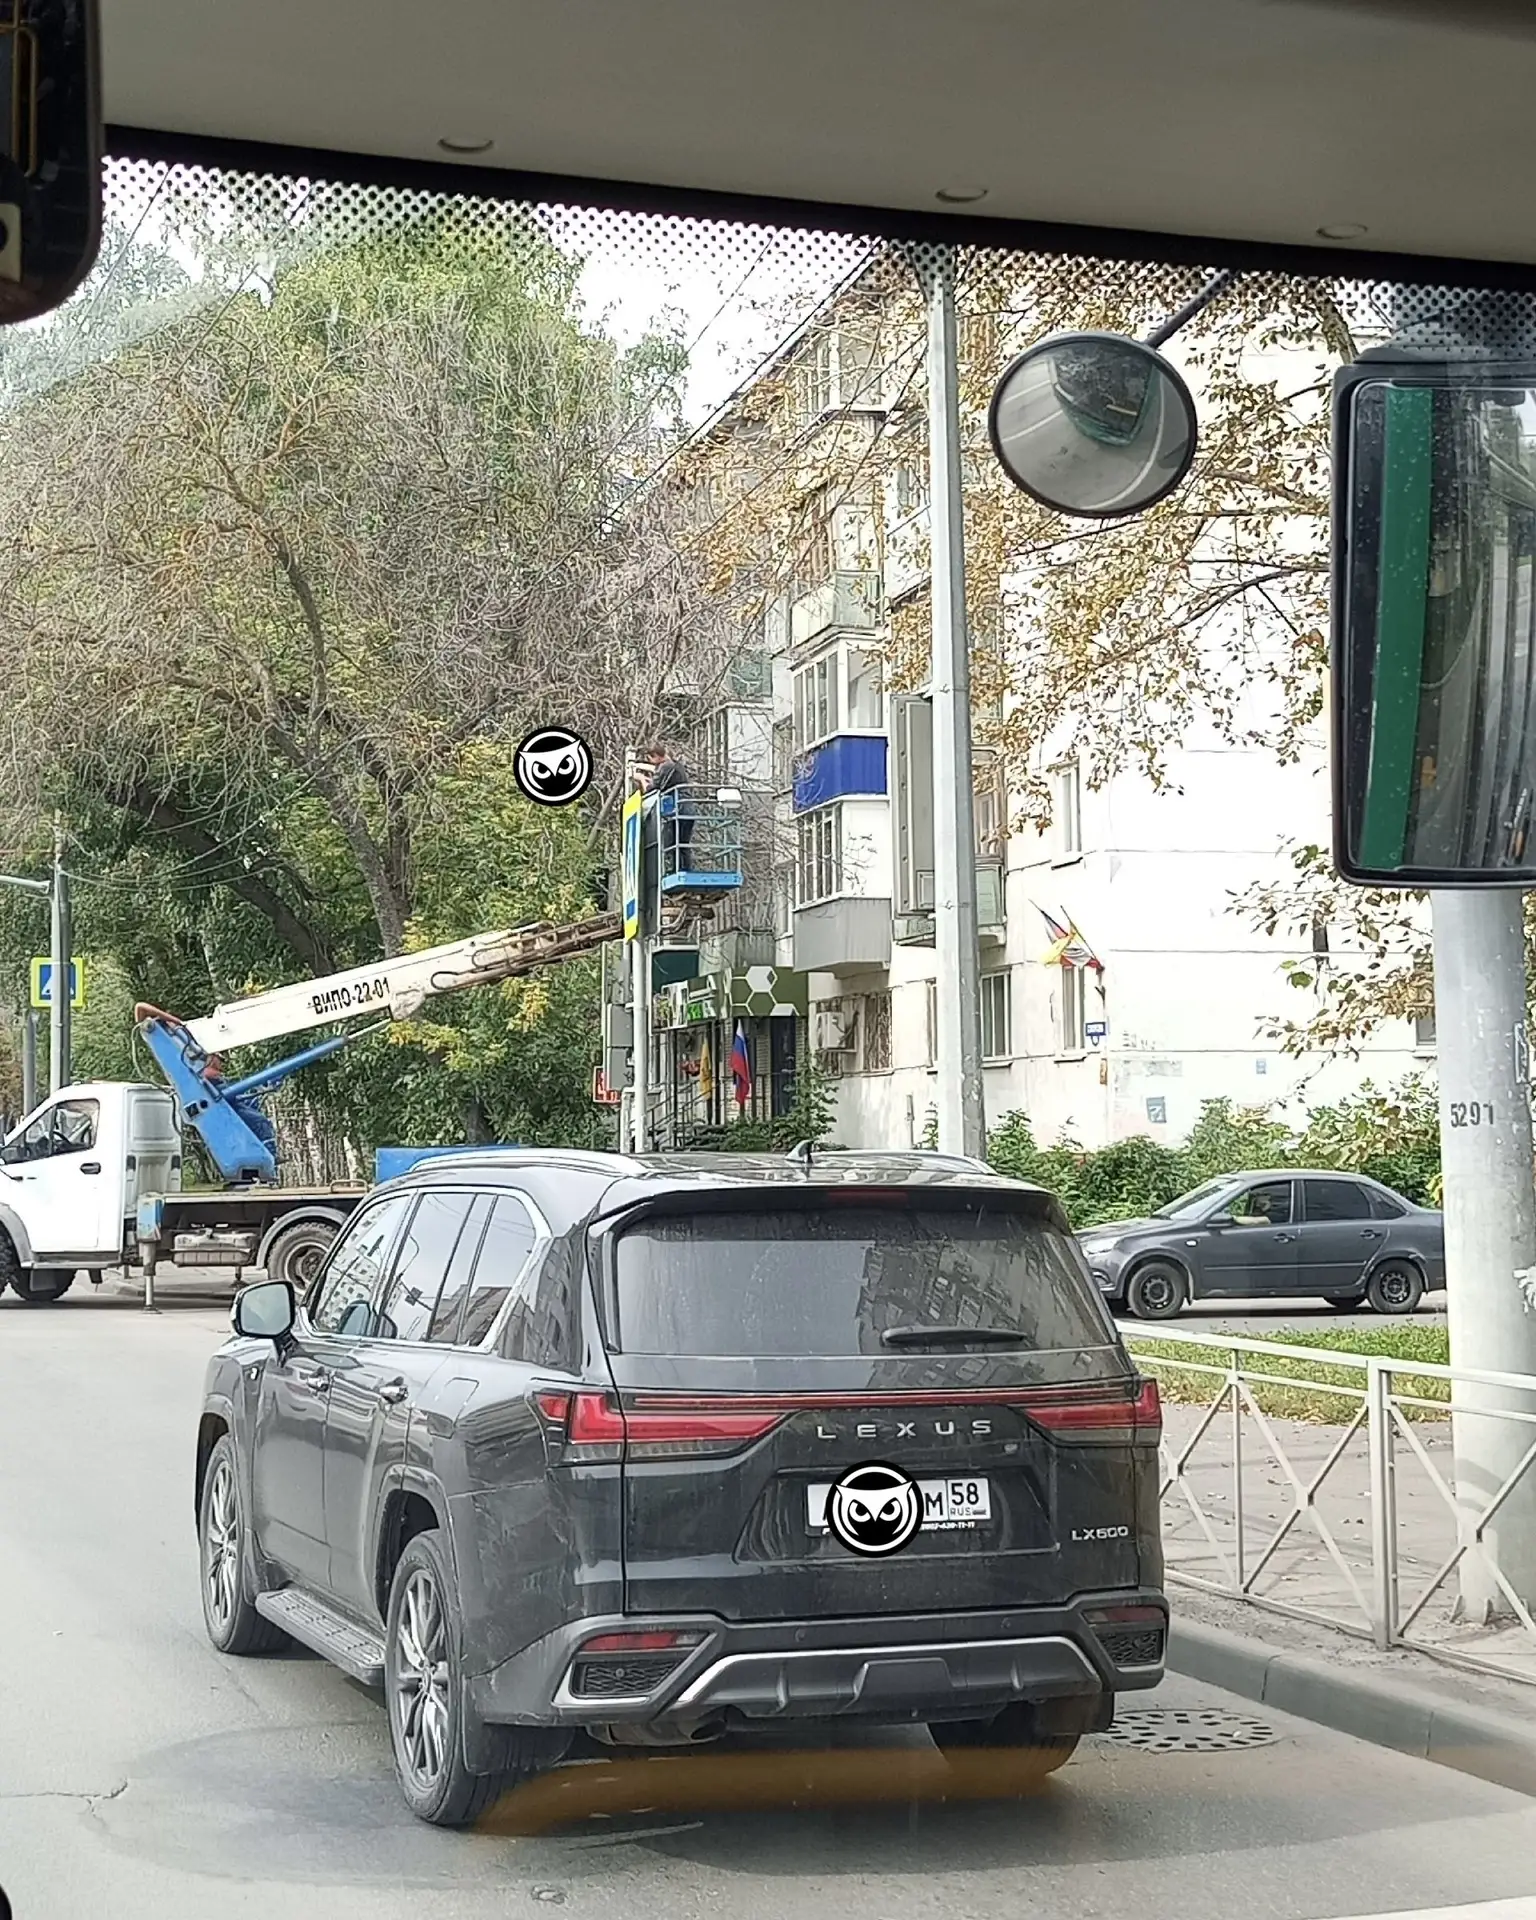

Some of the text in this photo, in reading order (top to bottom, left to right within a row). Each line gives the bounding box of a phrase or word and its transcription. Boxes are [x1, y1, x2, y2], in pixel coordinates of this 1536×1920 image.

[312, 977, 390, 1014] ВИПО-22-01
[1451, 1102, 1494, 1128] 5291
[817, 1420, 992, 1439] LEXUS
[951, 1483, 980, 1506] 58
[950, 1508, 971, 1517] RUS
[1072, 1526, 1129, 1541] LX600
